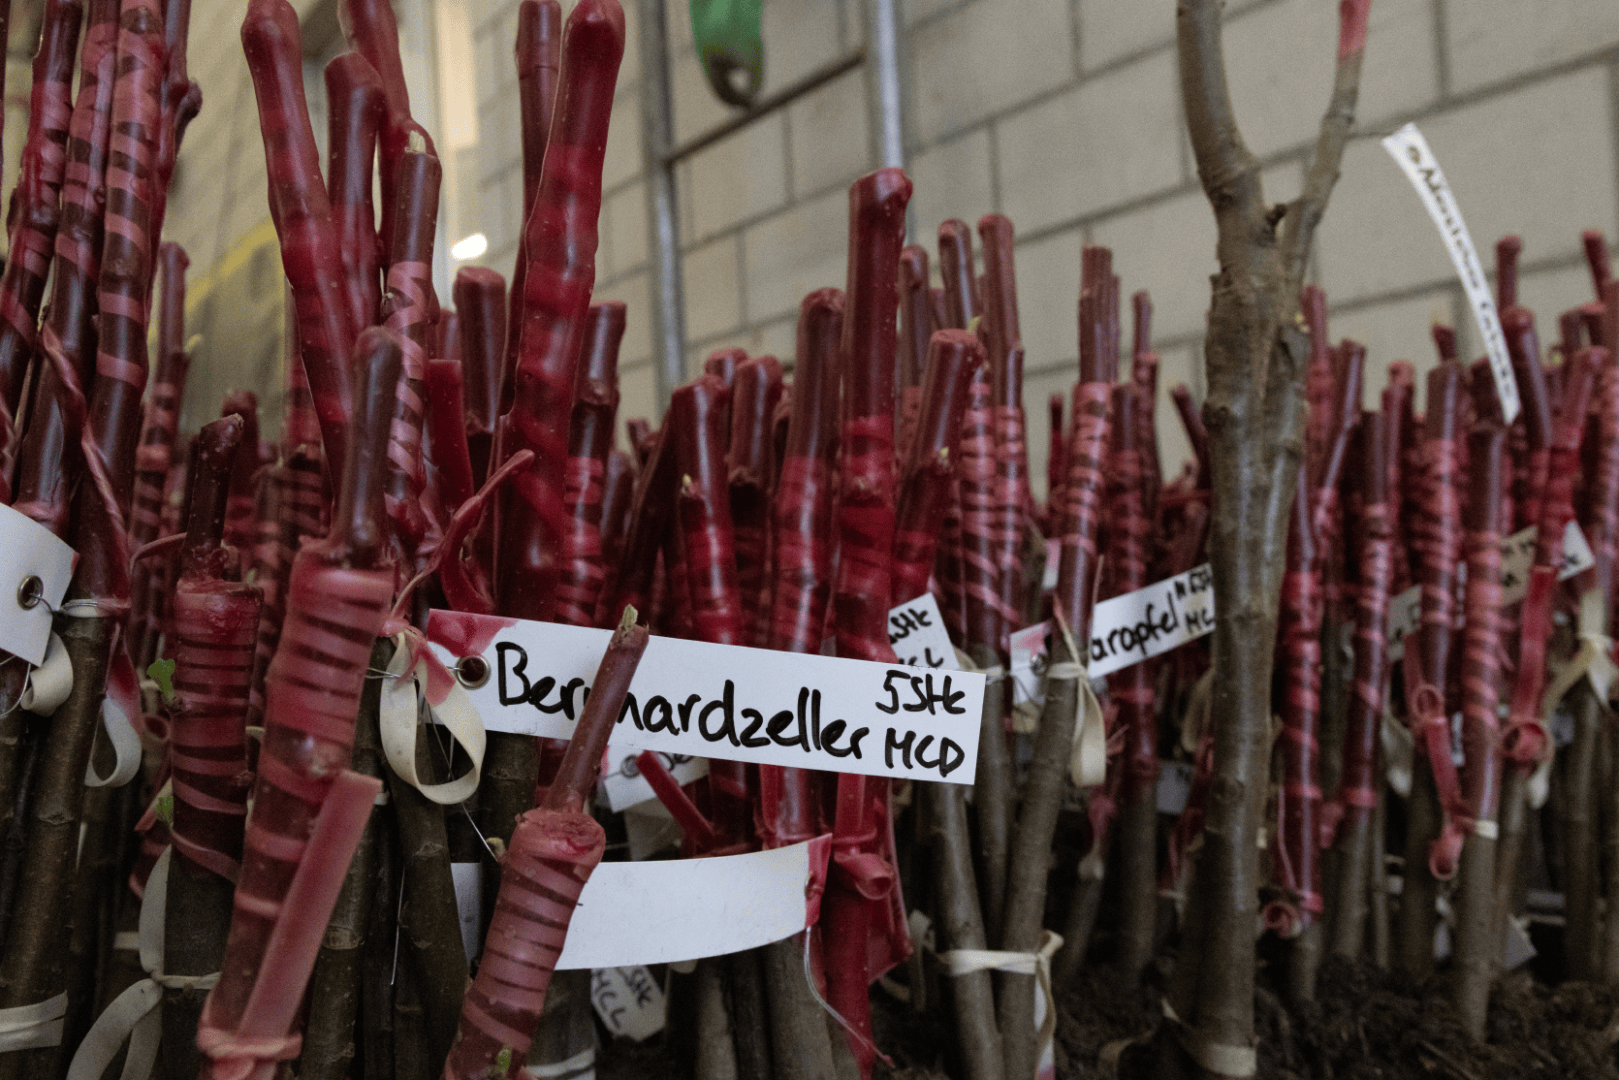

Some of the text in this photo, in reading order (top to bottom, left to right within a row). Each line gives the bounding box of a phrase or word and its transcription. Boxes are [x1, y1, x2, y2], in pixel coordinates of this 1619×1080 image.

[889, 607, 932, 645] Stk
[1090, 591, 1179, 661] arapfel
[495, 641, 870, 760] Berardzeller
[884, 727, 966, 779] MCD
